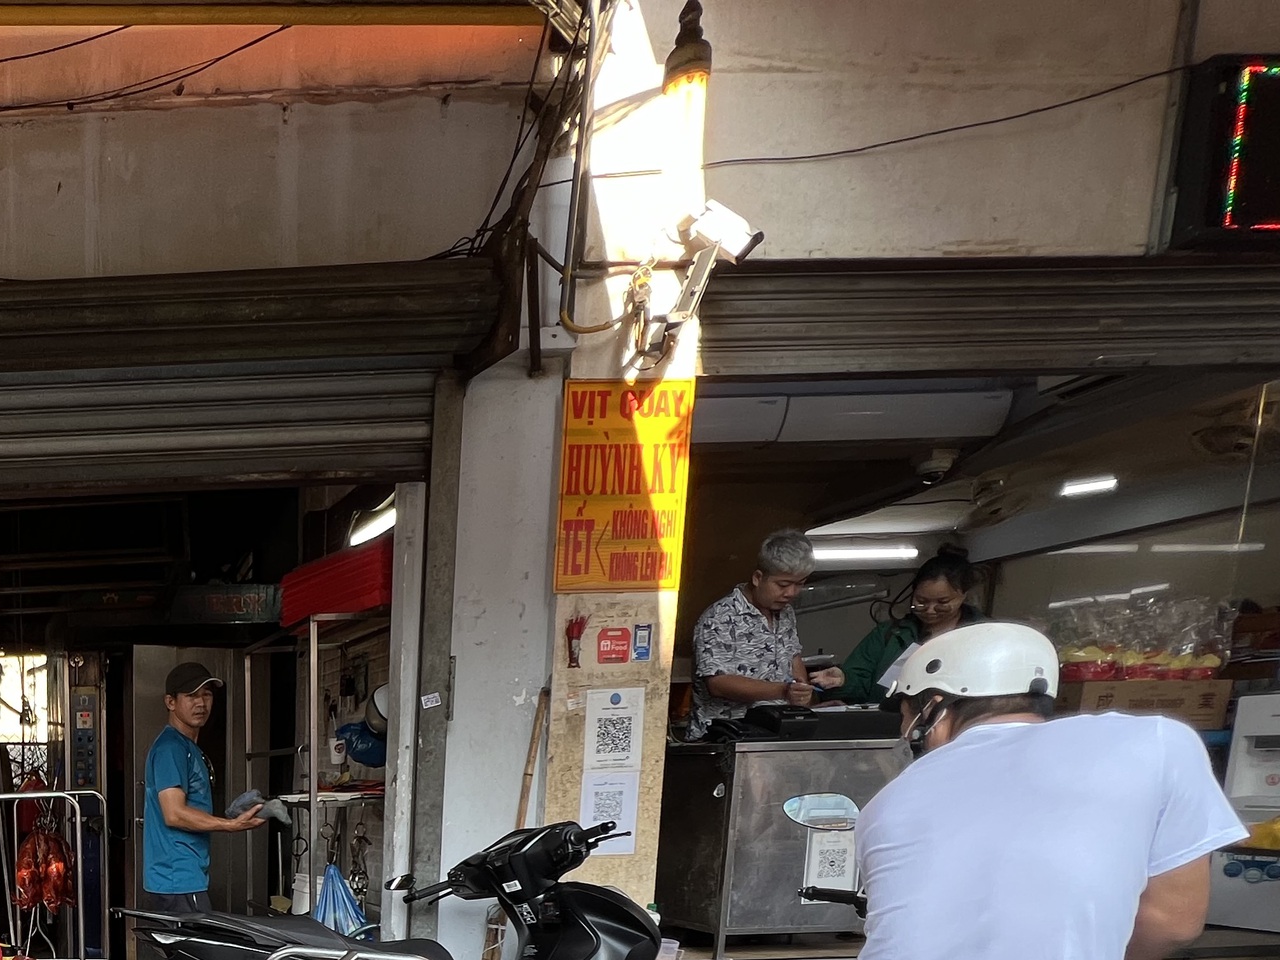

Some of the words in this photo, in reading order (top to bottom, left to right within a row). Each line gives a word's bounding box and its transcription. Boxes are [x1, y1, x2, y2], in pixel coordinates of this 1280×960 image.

[571, 390, 612, 425] VỊT
[619, 389, 686, 421] QUAY
[565, 431, 644, 496] HUỲNH
[650, 431, 684, 494] KÝ
[563, 500, 596, 575] TẾT
[611, 503, 649, 540] KHÔNG
[608, 546, 639, 582] KHÔNG
